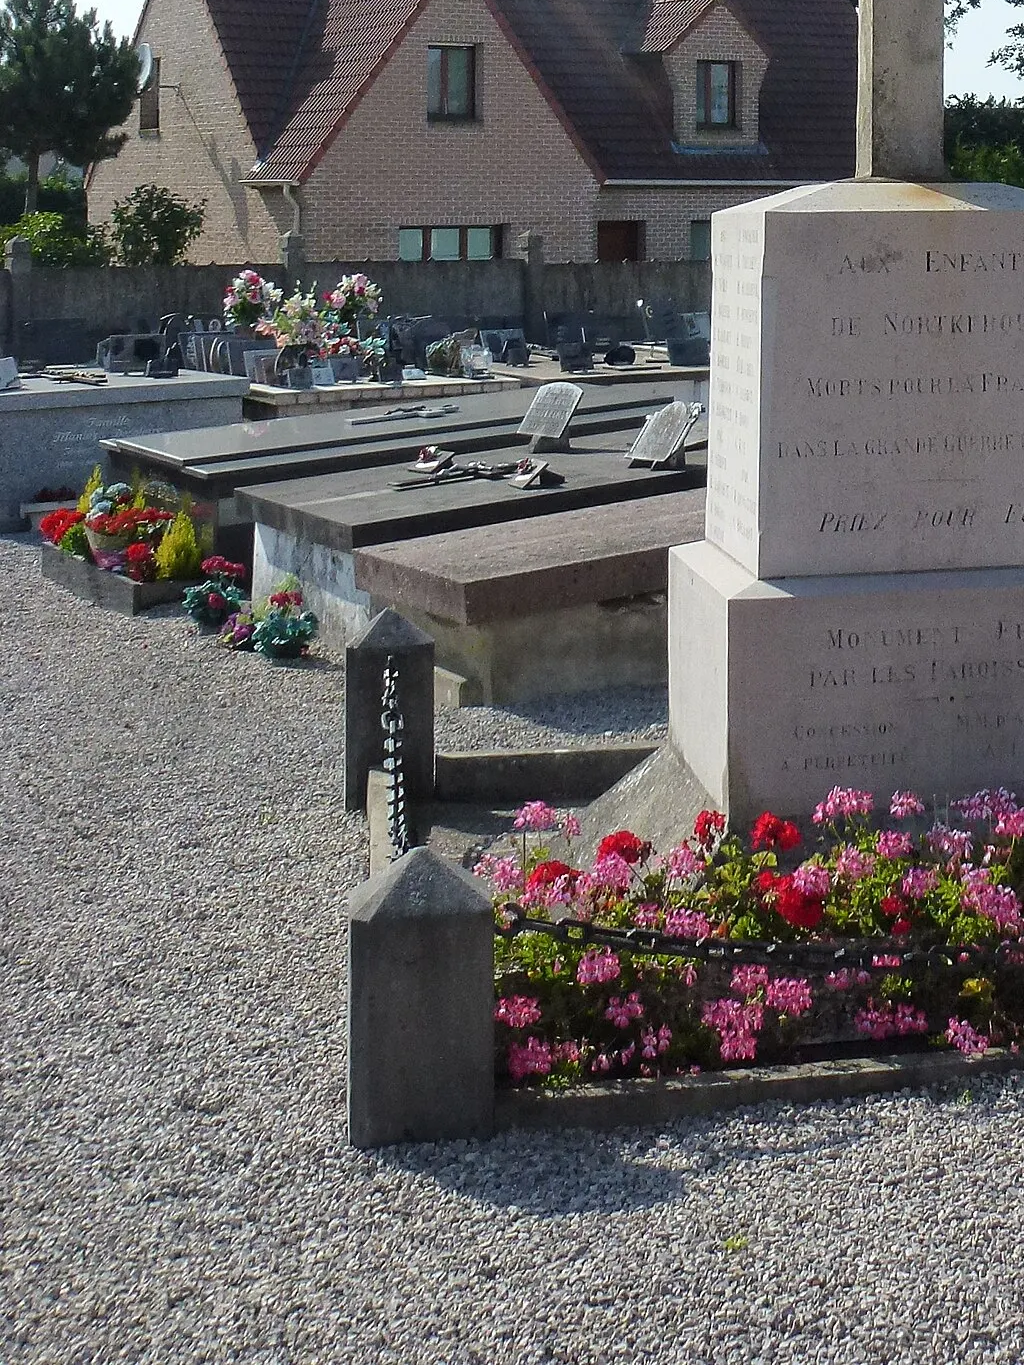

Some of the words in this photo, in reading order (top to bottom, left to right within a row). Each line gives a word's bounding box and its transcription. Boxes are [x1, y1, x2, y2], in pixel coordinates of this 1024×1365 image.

[839, 253, 890, 275] AUX
[831, 316, 863, 336] DE
[807, 377, 882, 397] MORTS
[889, 377, 942, 395] POUR
[949, 375, 975, 393] LA
[778, 440, 828, 459] DANS
[833, 439, 860, 456] LA
[864, 435, 940, 455] GRANDE
[944, 433, 1014, 452] GUERRE
[819, 511, 888, 533] PRIEZ
[913, 507, 976, 530] POUR
[810, 669, 856, 687] PAR
[871, 664, 916, 684] LES
